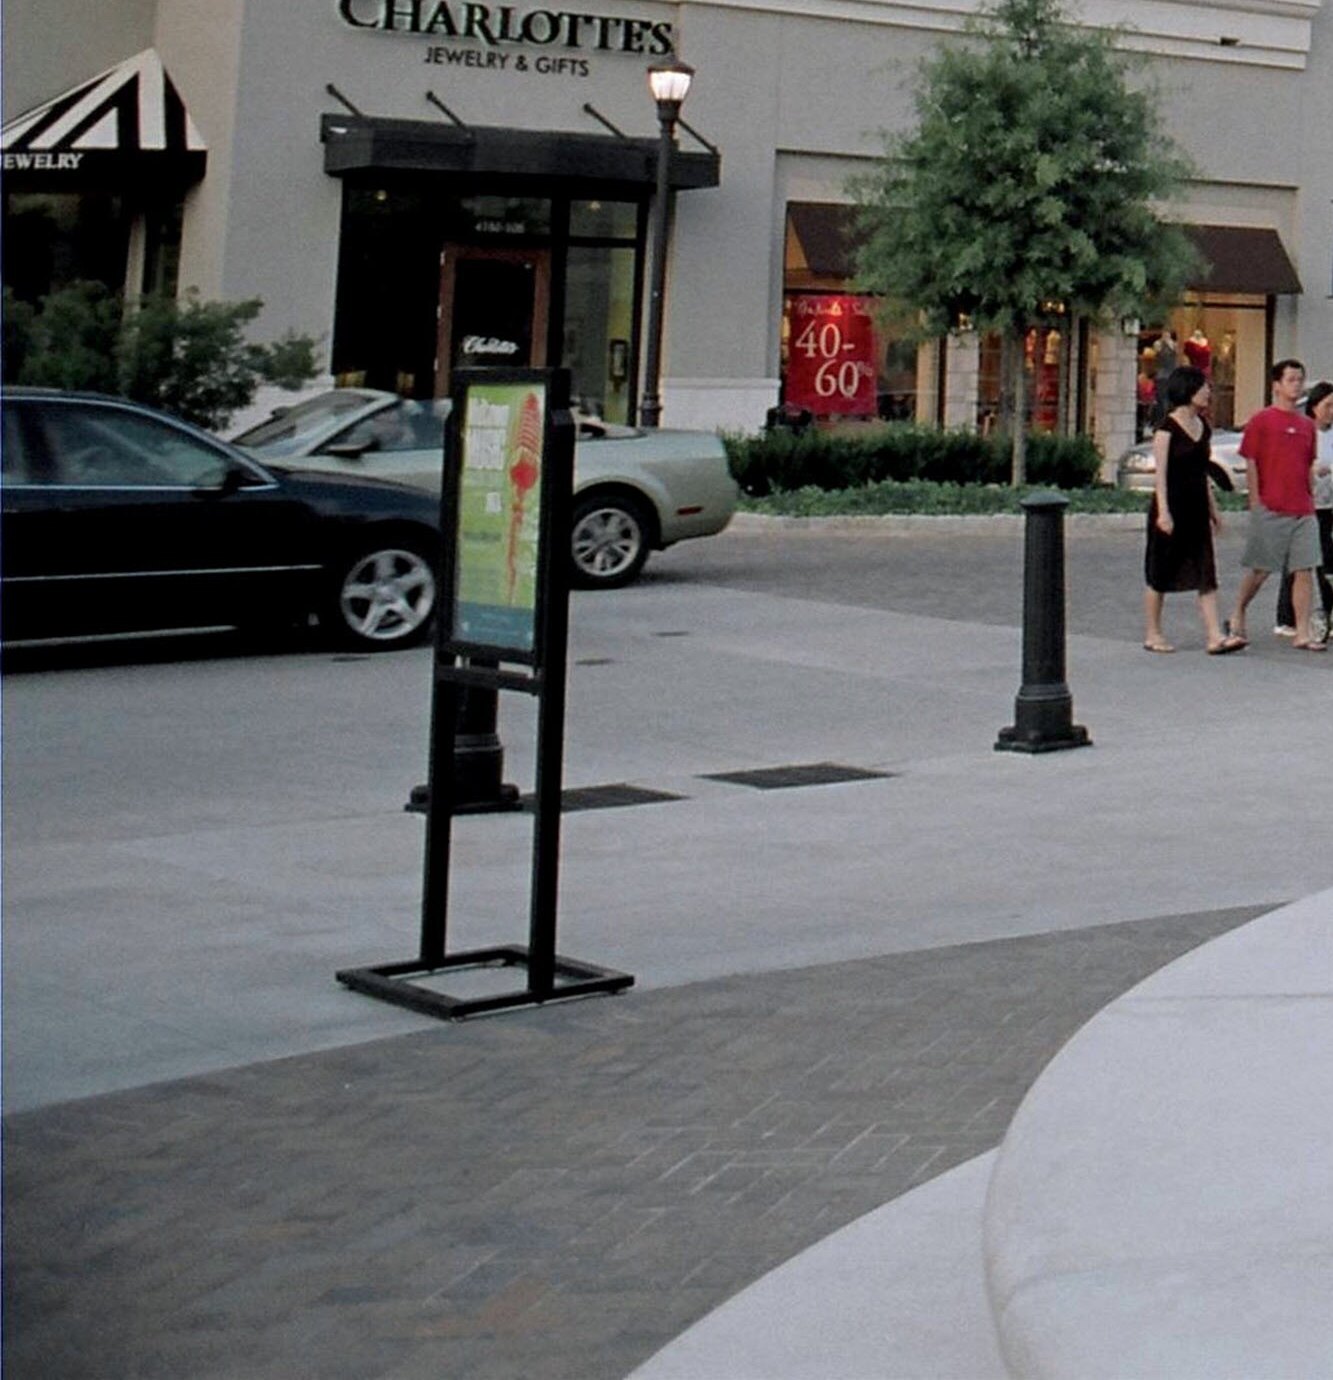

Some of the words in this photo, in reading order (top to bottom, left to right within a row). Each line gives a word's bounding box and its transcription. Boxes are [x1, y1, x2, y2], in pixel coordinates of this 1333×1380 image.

[424, 47, 510, 70] JEWELRY
[515, 51, 529, 71] &
[535, 56, 591, 77] GIFTS
[0, 152, 83, 169] EWELRY
[795, 320, 855, 358] 40-
